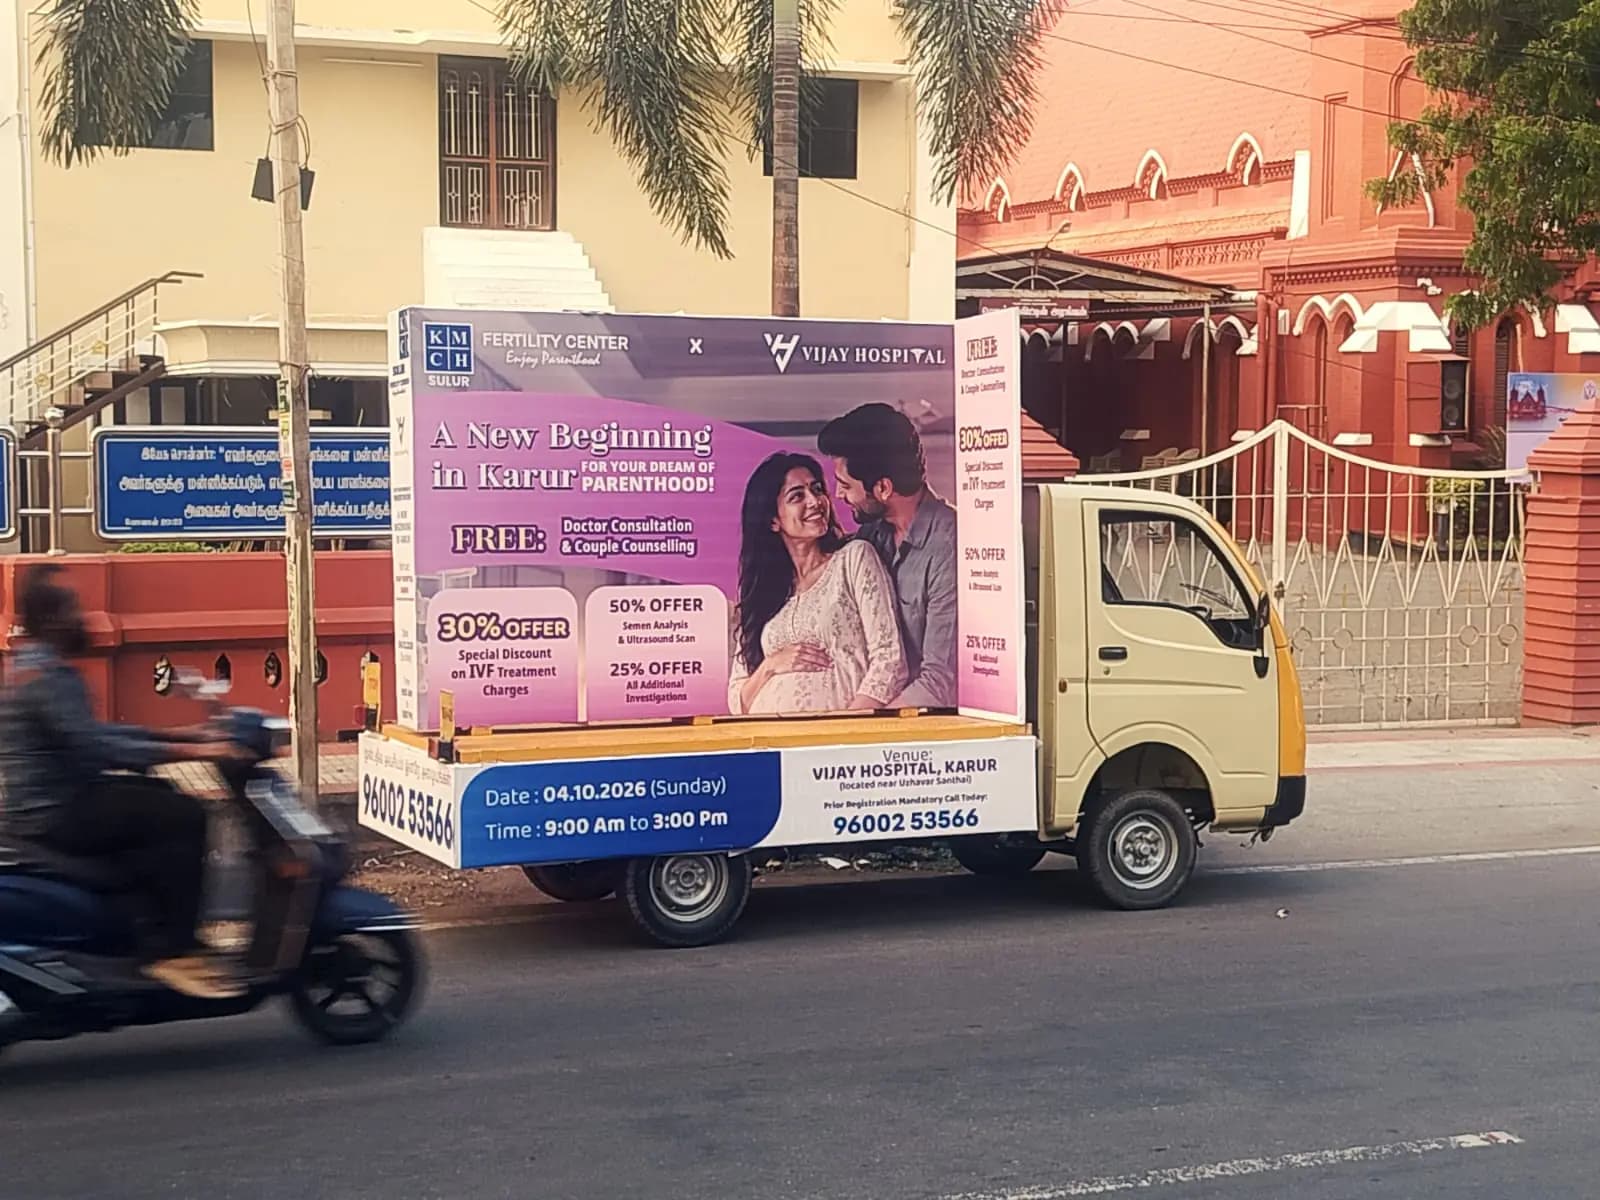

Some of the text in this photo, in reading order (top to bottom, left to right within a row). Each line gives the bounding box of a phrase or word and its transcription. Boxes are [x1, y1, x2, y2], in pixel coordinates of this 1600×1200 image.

[482, 332, 629, 350] FERTILITY CENTER
[505, 350, 601, 368] Enjoy Parenthood
[801, 346, 947, 365] VIJAY HOSPITAL
[427, 376, 470, 387] SULUR
[430, 420, 714, 457] A New Beginning
[959, 425, 1009, 452] 30% OFFER
[431, 460, 579, 490] in Karur
[580, 460, 716, 473] FOR YOUR DREAM OF
[580, 476, 716, 492] PARENTHOOD!
[563, 518, 694, 534] Doctor Consultation
[453, 525, 546, 553] FREE:
[561, 539, 696, 558] & Couple Counselling
[609, 598, 704, 613] 50% OFFER
[438, 612, 570, 642] 30% OFFER
[622, 619, 689, 631] Semen Analysis
[626, 634, 674, 644] Ultrasound
[675, 634, 696, 643] Scan
[458, 648, 552, 663] Special Discount
[451, 663, 557, 679] on IVF Treatment
[609, 660, 703, 677] 25% OFFER
[483, 684, 529, 699] Charges
[626, 678, 685, 690] All Additional
[625, 692, 688, 704] Investigations
[882, 749, 933, 762] Venue:
[812, 758, 998, 781] VIJAY HOSPITAL, KARUR
[485, 788, 530, 807] Date
[543, 780, 647, 803] 04.10.2026
[650, 775, 727, 799] (Sunday)
[839, 780, 876, 792] (located
[876, 779, 897, 789] near
[823, 793, 989, 810] Prior Registration Mandatory Call Today:
[363, 773, 453, 850] 96002 53566
[485, 823, 532, 841] Time
[544, 818, 589, 837] 9:00
[592, 816, 626, 834] Am
[629, 815, 649, 832] to
[652, 812, 696, 830] 3:00
[699, 809, 728, 827] Pm
[833, 807, 980, 836] 96002 53566
